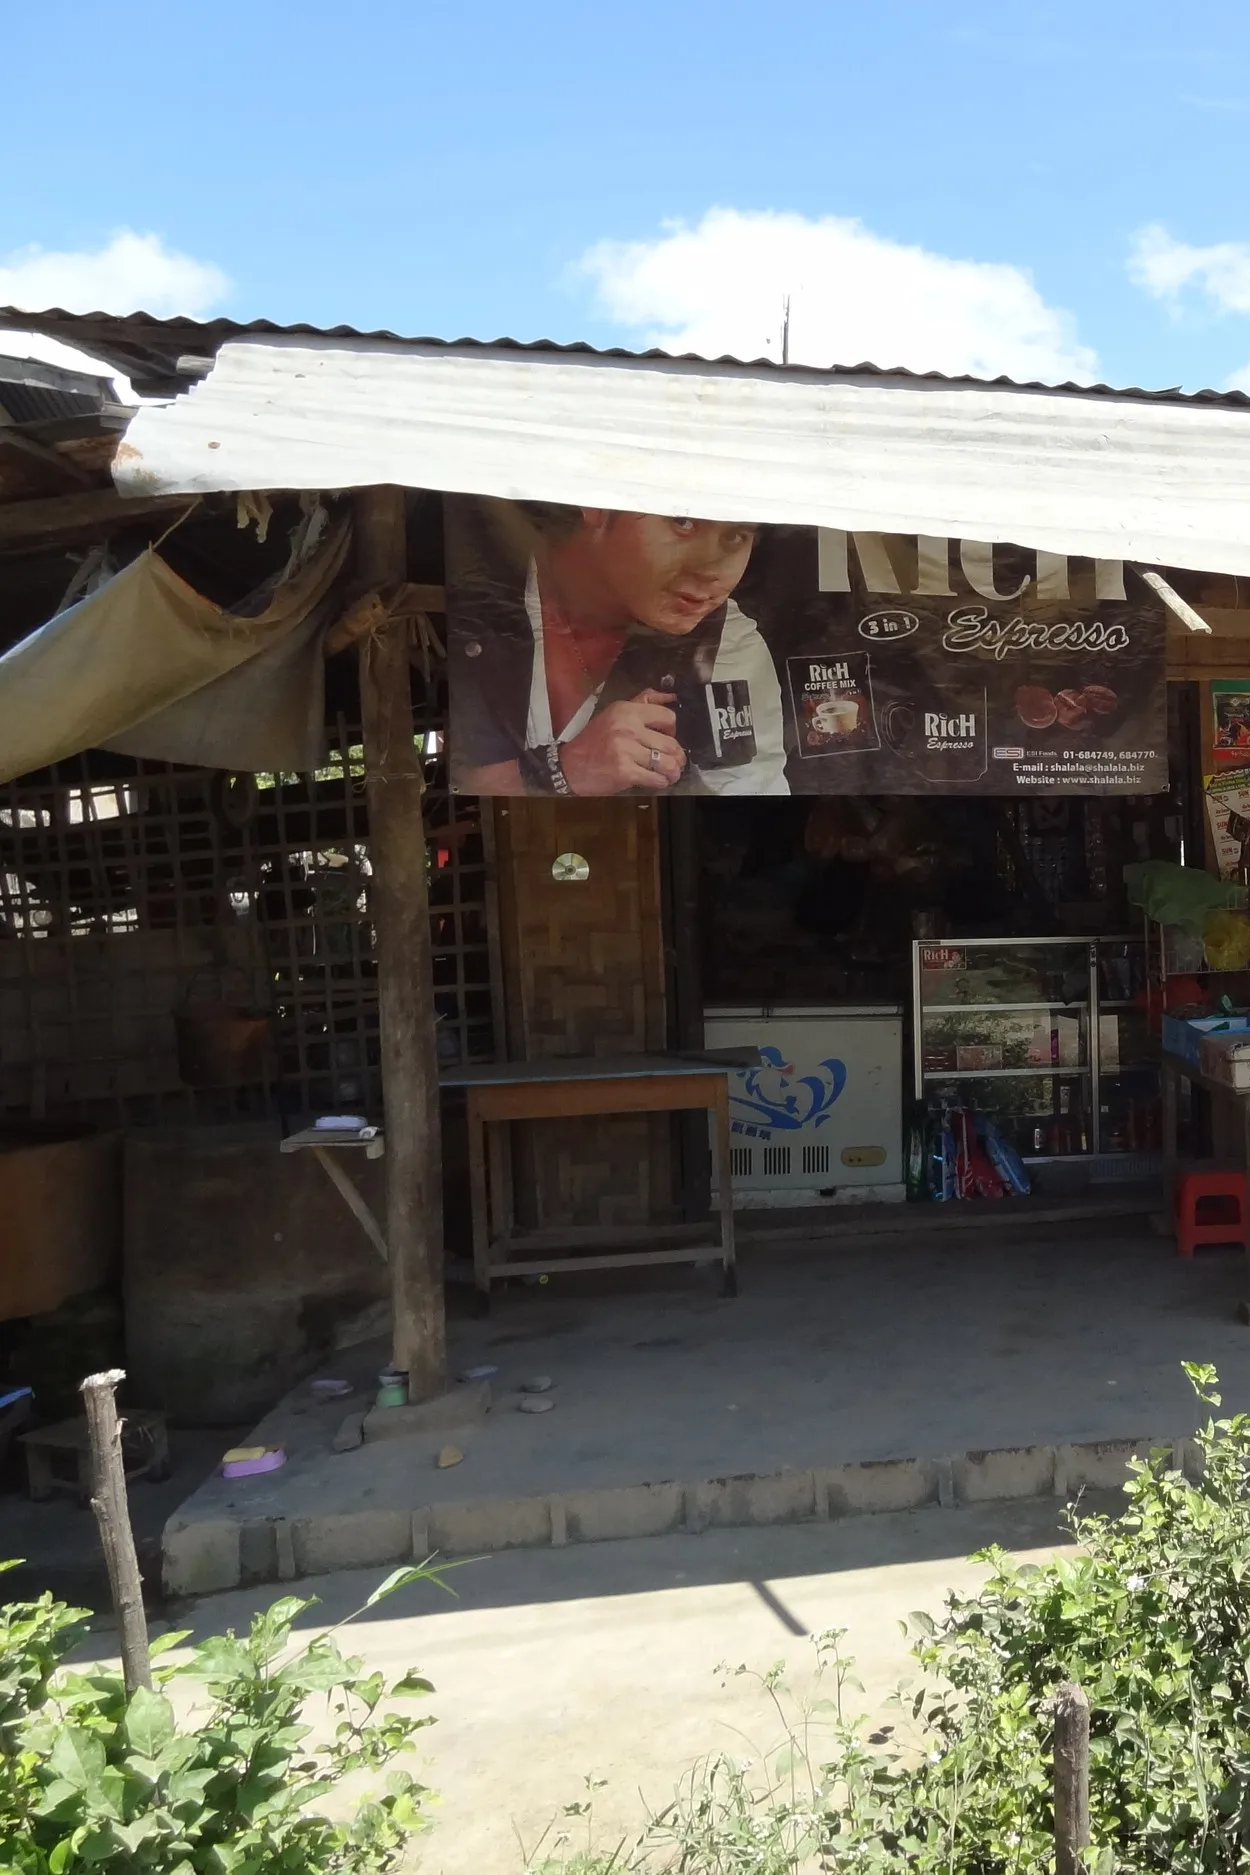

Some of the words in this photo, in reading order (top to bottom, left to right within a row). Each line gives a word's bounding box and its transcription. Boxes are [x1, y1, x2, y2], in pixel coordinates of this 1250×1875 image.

[868, 621, 881, 634] 3
[883, 619, 901, 633] in
[903, 617, 912, 630] 1
[943, 605, 1130, 660] Espresso
[804, 680, 838, 691] COFFEE
[839, 679, 857, 689] MIX
[928, 737, 975, 751] Espresso
[1063, 751, 1117, 761] 01-684749,
[1012, 762, 1044, 772] E-mail
[1050, 762, 1145, 773] shalala@shalala.biz
[1016, 776, 1055, 785] Website
[1062, 776, 1142, 785] www.shalala.biz
